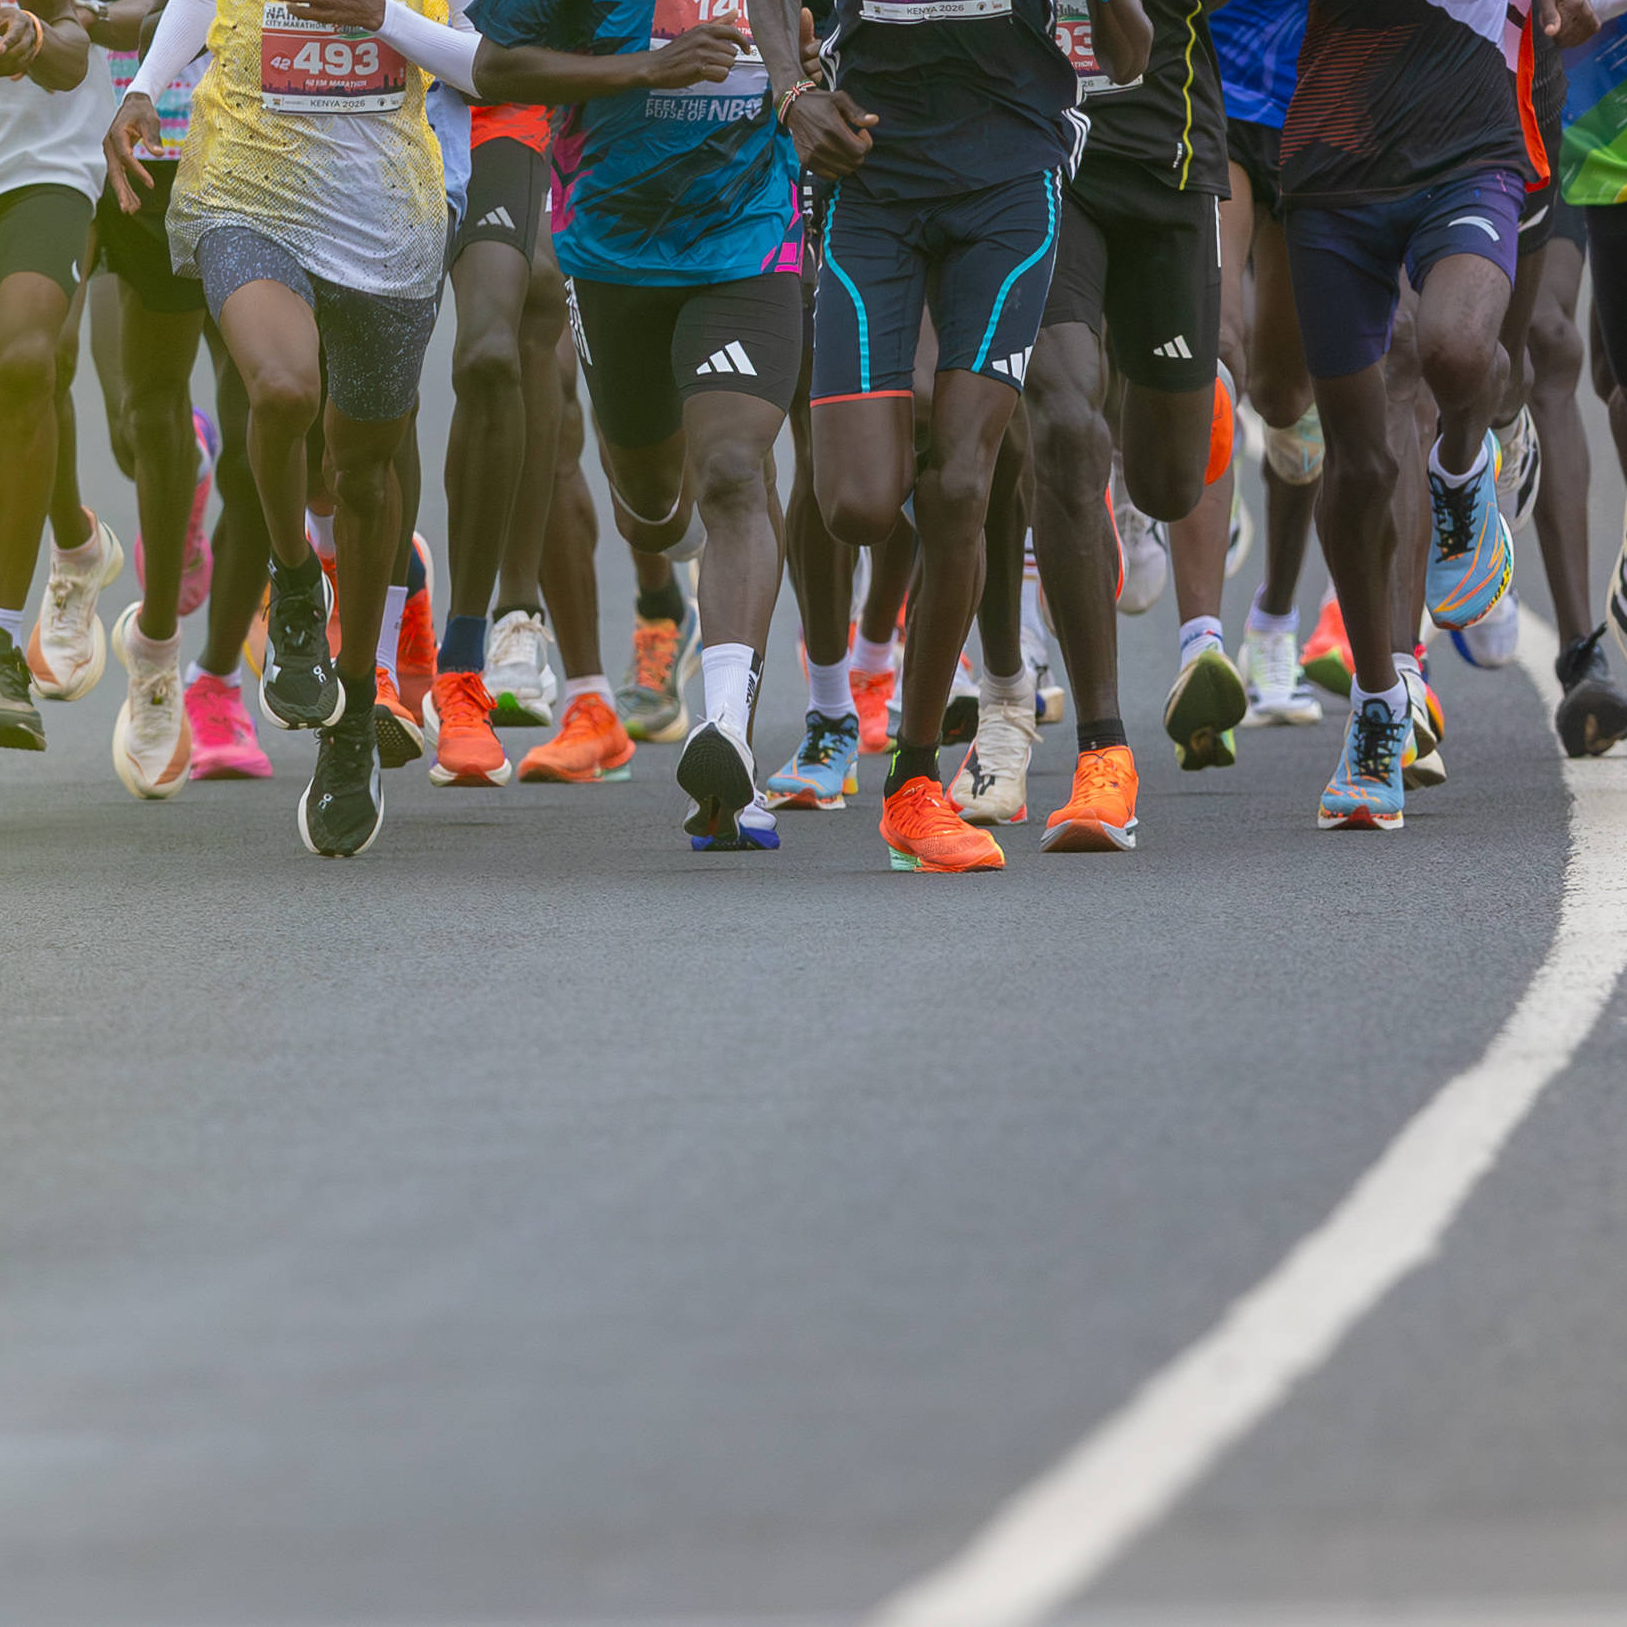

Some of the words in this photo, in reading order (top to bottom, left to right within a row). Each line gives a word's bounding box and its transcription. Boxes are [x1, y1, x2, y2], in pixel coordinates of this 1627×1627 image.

[906, 6, 938, 16] KENYA
[939, 4, 964, 13] 2026
[1055, 25, 1095, 57] 93
[270, 56, 291, 71] 42
[293, 41, 379, 76] 493
[310, 99, 340, 108] KENYA
[342, 99, 365, 109] 2026
[646, 98, 676, 110] FEEL
[681, 99, 708, 111] THE
